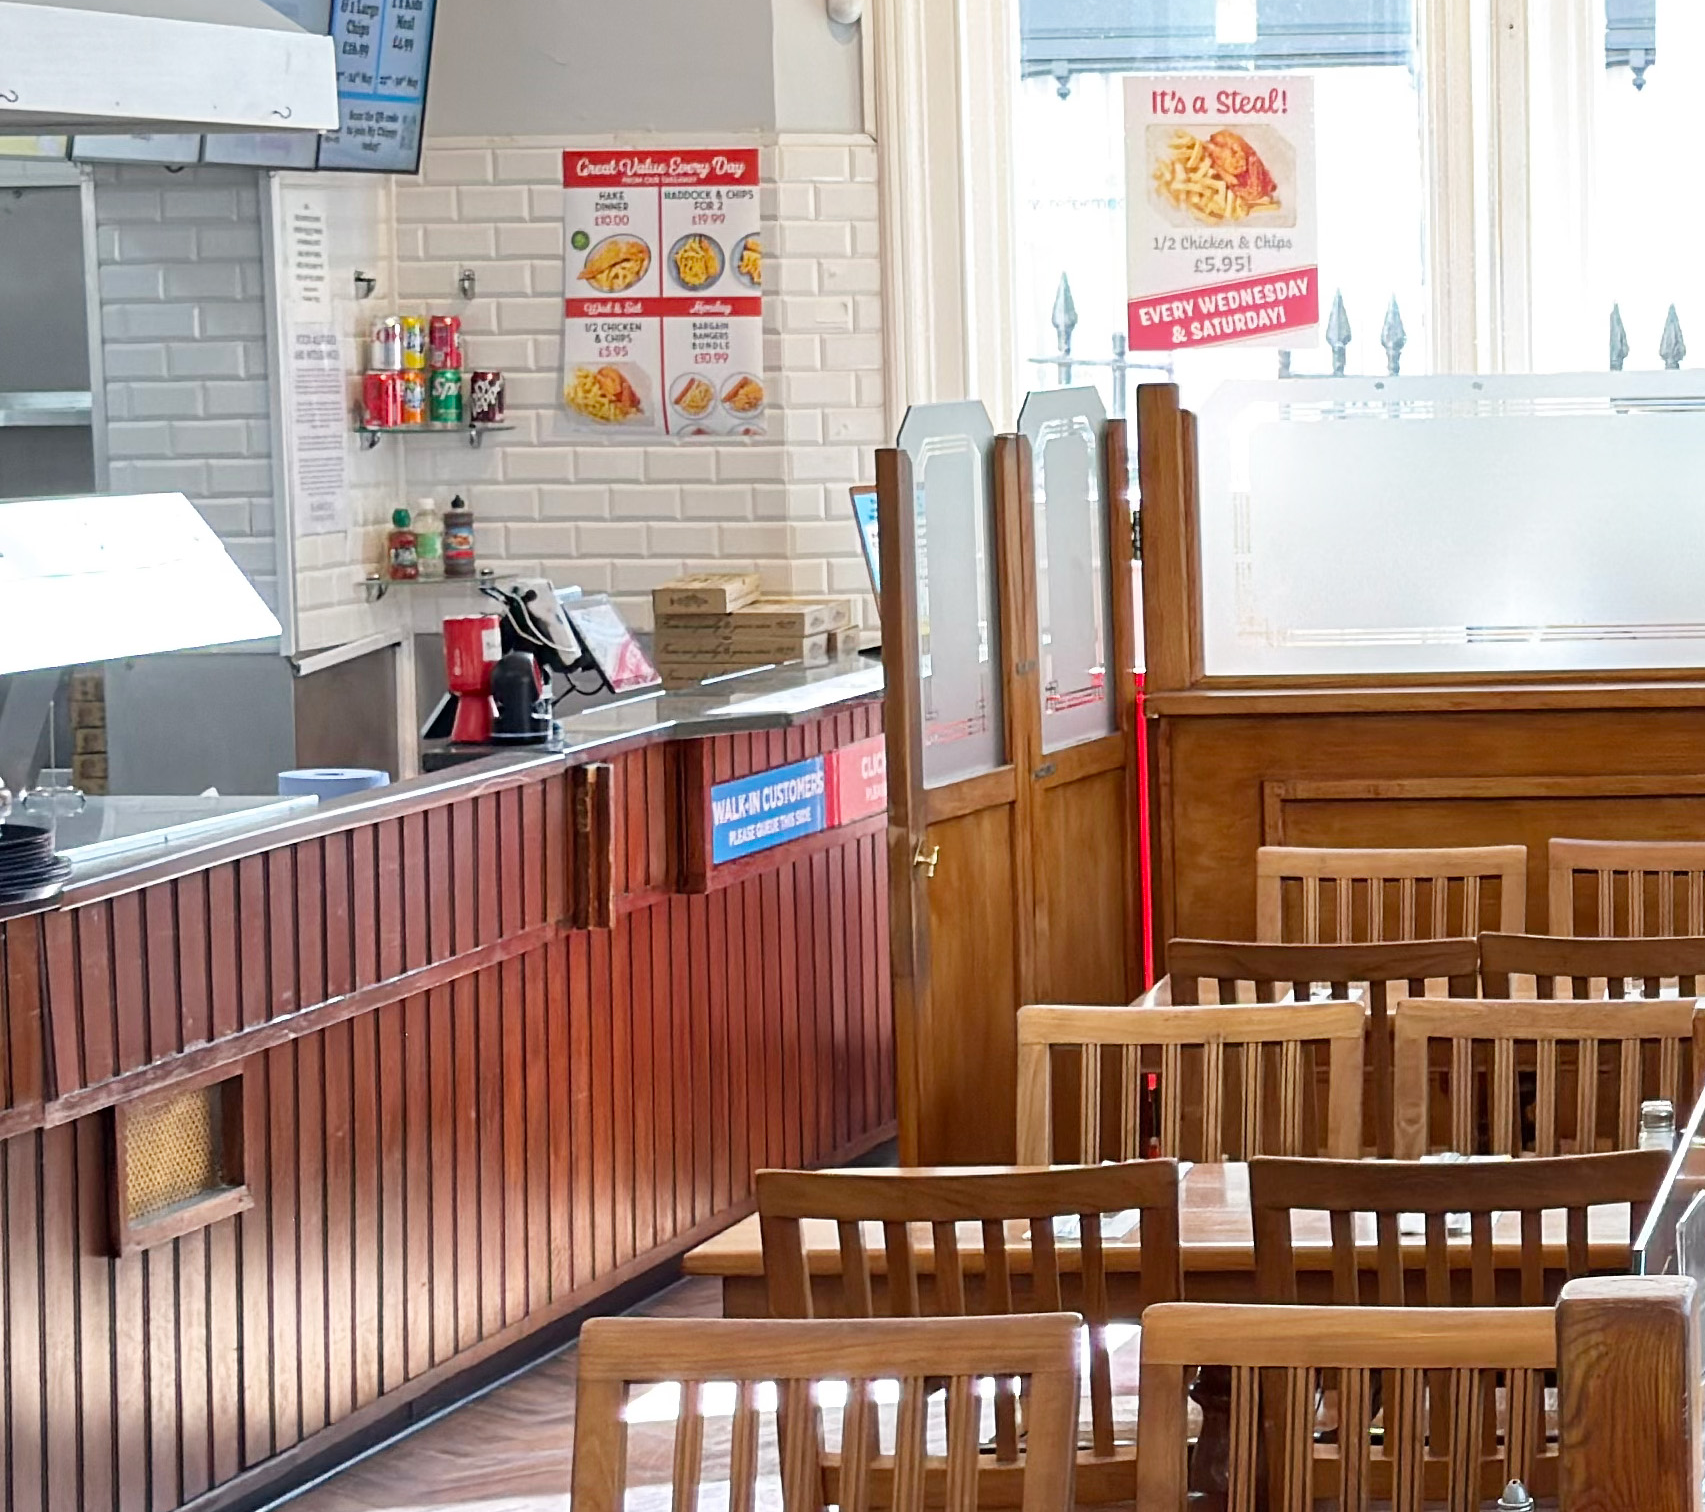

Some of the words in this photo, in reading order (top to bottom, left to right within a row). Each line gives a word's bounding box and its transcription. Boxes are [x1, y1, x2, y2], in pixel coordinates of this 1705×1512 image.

[1152, 90, 1186, 114] It's
[1193, 95, 1208, 114] a
[1216, 88, 1288, 114] Steal!
[576, 158, 617, 177] Great
[619, 158, 666, 176] Value
[669, 156, 711, 178] Every
[712, 156, 746, 179] Day
[599, 191, 624, 200] HAKE
[664, 190, 711, 200] HADDOCK
[726, 190, 754, 200] CHIPS
[595, 202, 629, 212] DINNER
[694, 201, 714, 211] FOR
[716, 201, 723, 211] 2
[594, 214, 629, 226] £10.00
[1153, 236, 1177, 251] 1/2
[1181, 237, 1234, 250] Chicken
[1238, 236, 1249, 250] &
[1254, 235, 1293, 252] Chips
[1194, 255, 1253, 274] £5.95!
[1139, 299, 1194, 326] EVERY
[1198, 277, 1309, 315] WEDNESDAY
[601, 322, 642, 332] CHICKEN
[1172, 325, 1188, 344] &
[1190, 305, 1287, 340] SATURDAY!
[605, 334, 632, 344] CHIPS
[692, 341, 730, 350] BUNDLE
[598, 346, 628, 358] £5.95
[712, 790, 760, 826] WALK-IN
[762, 770, 824, 812] CUSTOMERS
[729, 826, 756, 846] PLEASE
[756, 817, 779, 838] QUEUE
[796, 807, 811, 826] SIDE
